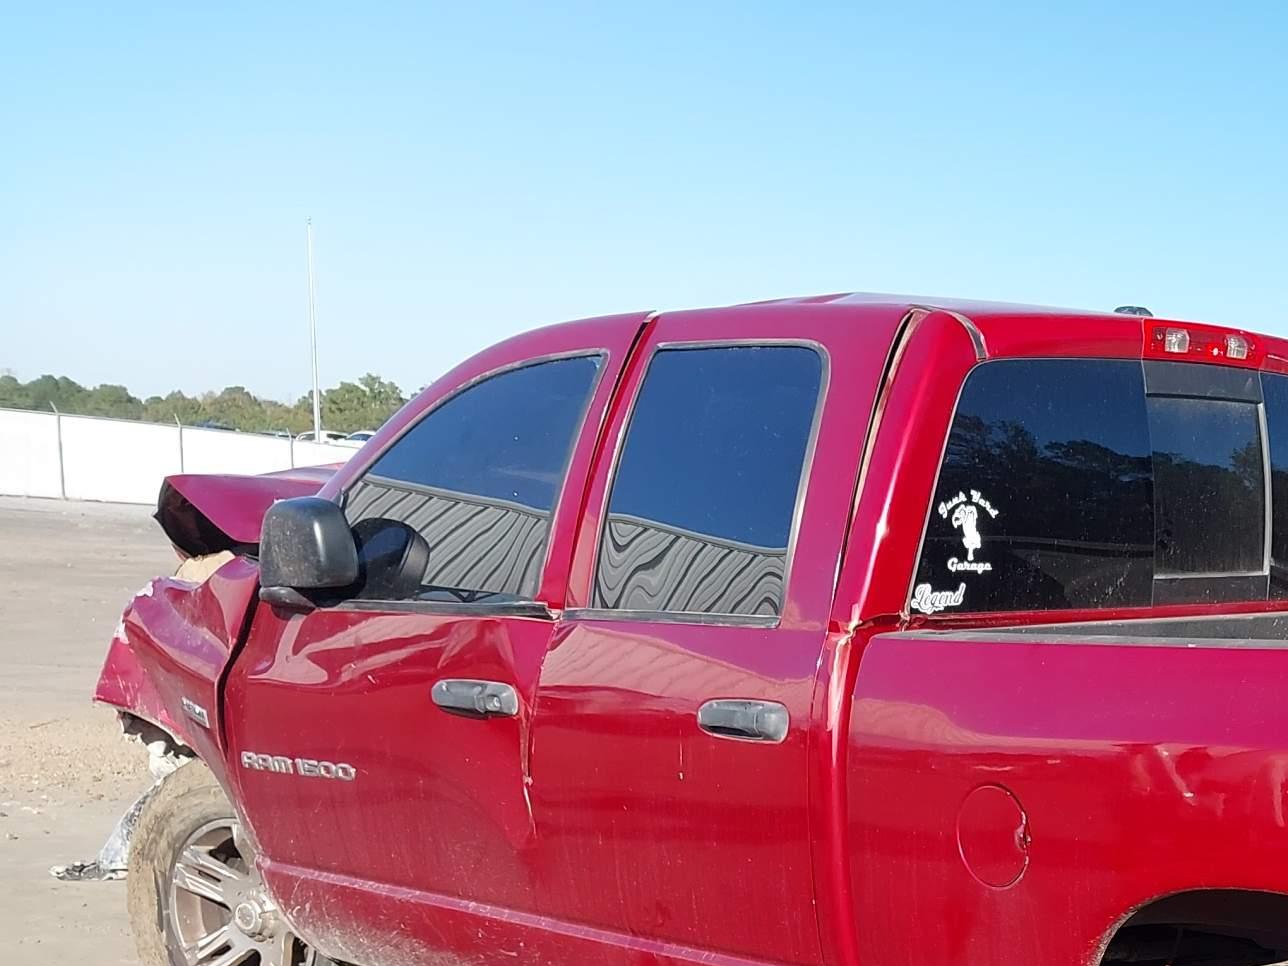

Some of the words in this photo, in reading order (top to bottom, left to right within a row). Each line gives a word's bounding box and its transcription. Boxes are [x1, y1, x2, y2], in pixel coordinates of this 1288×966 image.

[947, 557, 992, 574] Garage
[911, 582, 966, 614] Legend
[241, 751, 293, 775] RAM
[295, 757, 356, 781] 1500
